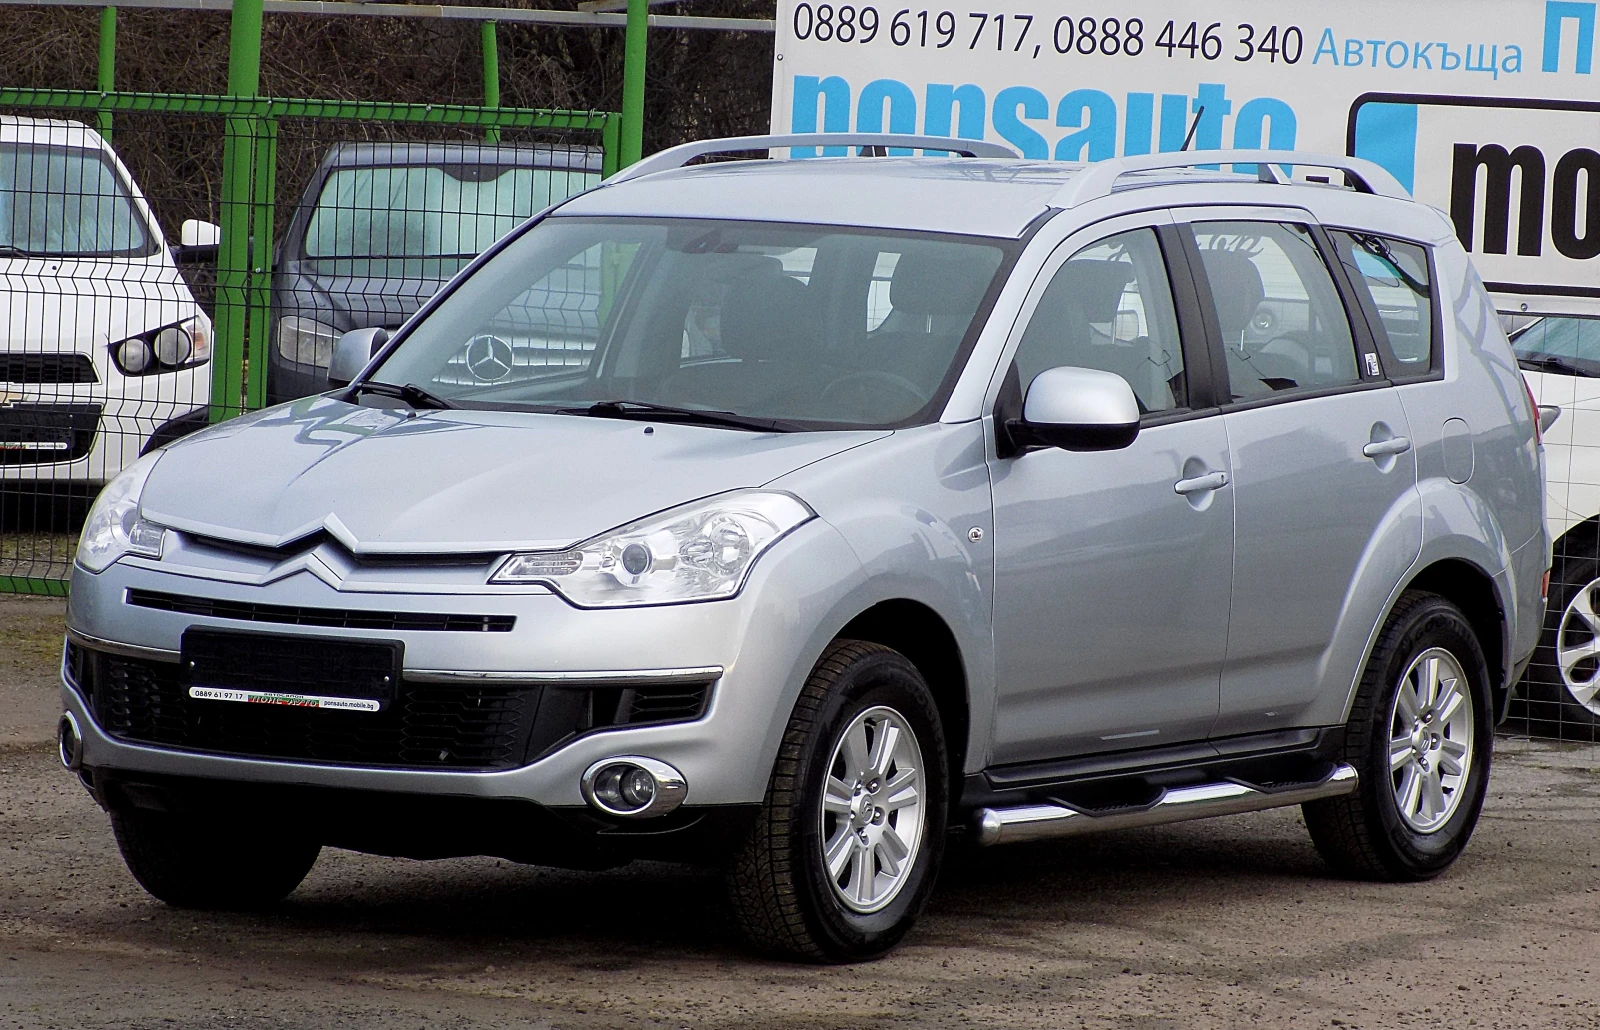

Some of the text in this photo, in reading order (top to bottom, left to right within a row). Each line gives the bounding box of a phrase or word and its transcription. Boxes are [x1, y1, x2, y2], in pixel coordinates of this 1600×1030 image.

[793, 2, 1304, 65] 0889 619 717, 0888 446 340
[1311, 27, 1523, 81] Автокъща
[194, 690, 213, 698] 0889
[224, 692, 233, 700] 97
